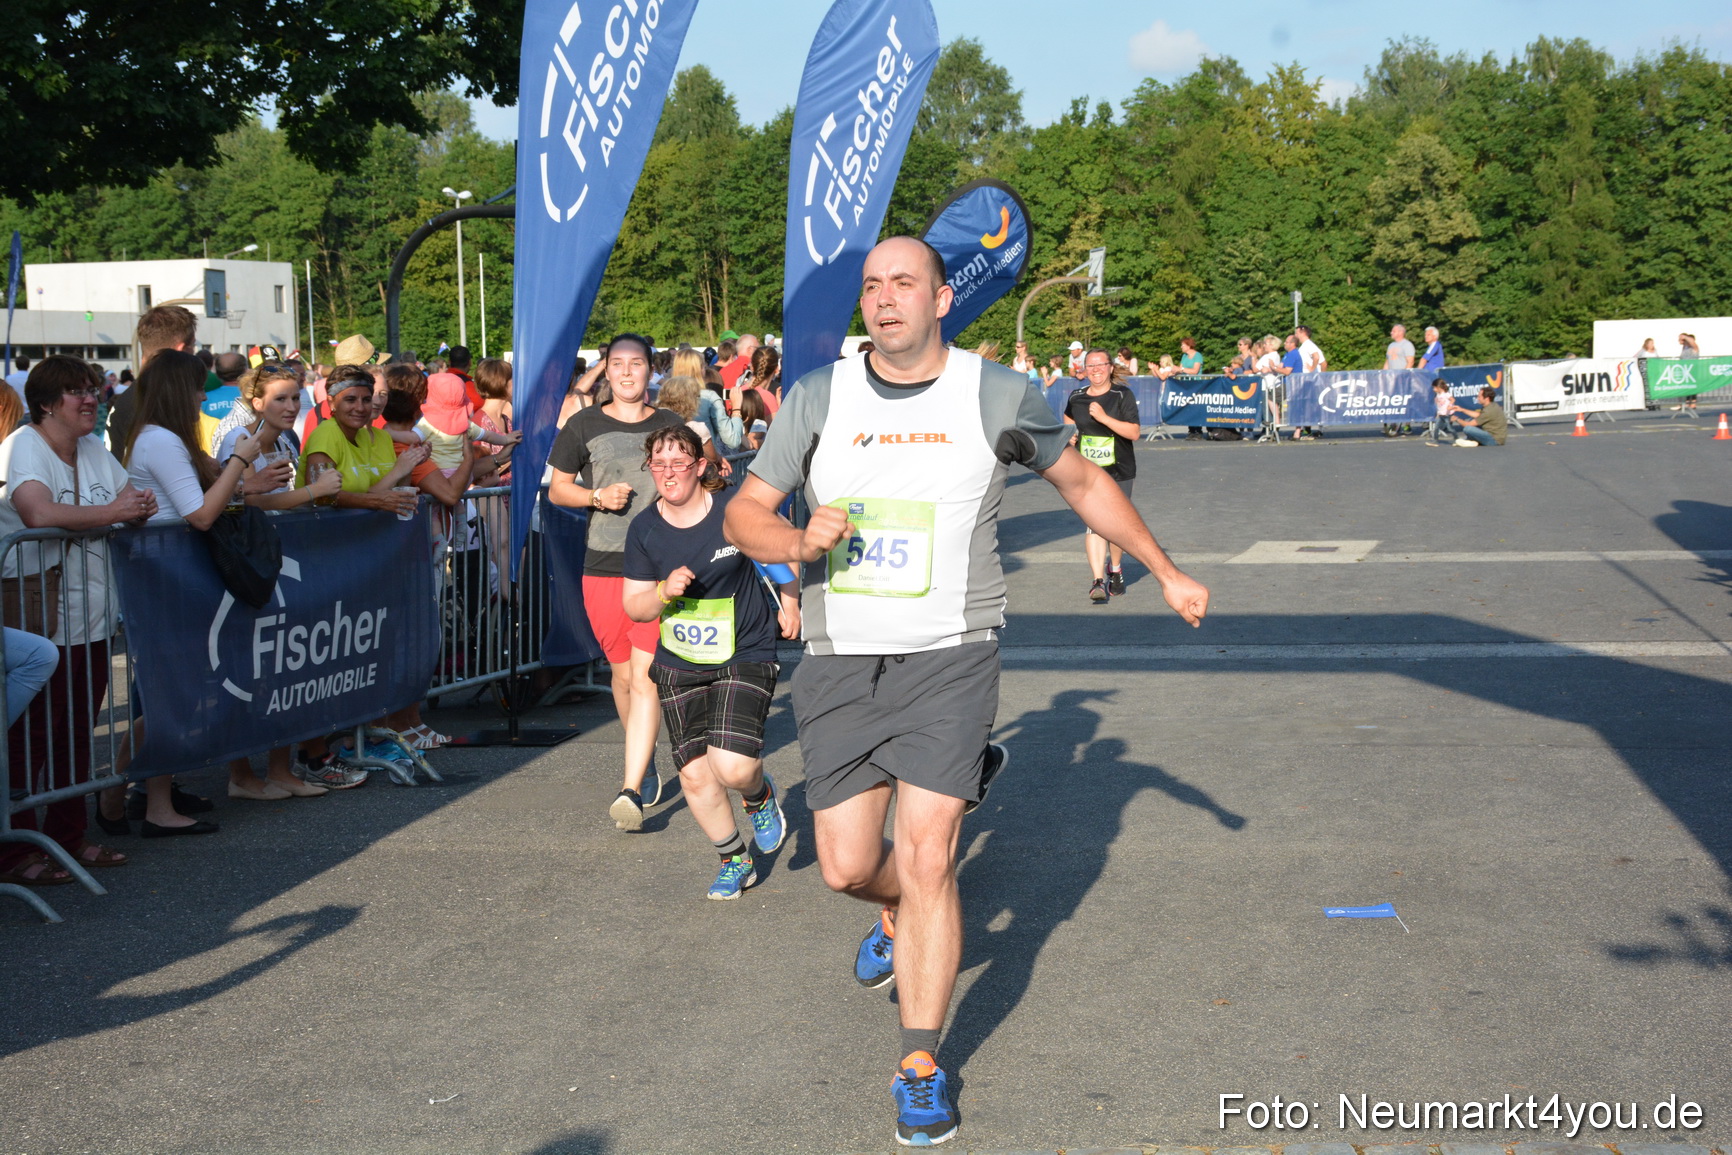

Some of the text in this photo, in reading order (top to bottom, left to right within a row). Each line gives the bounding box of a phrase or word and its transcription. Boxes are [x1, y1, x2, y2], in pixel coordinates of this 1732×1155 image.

[823, 14, 902, 231] Fischer
[852, 52, 914, 227] AUTOMOBILE
[953, 282, 978, 307] Druck
[993, 241, 1023, 275] Medien
[1561, 371, 1612, 396] swn
[1656, 363, 1697, 386] AOK
[1167, 391, 1234, 407] Frischmann
[1206, 405, 1256, 415] Druck und Medien
[1335, 392, 1413, 409] Fischer
[1343, 407, 1406, 416] AUTOMOBILE
[879, 433, 953, 444] KLEBL
[1083, 448, 1111, 459] 1220
[846, 536, 909, 569] 545
[253, 600, 387, 680] Fischer
[673, 623, 718, 646] 692
[266, 662, 378, 716] AUTOMOBILE
[914, 1058, 932, 1067] FILA
